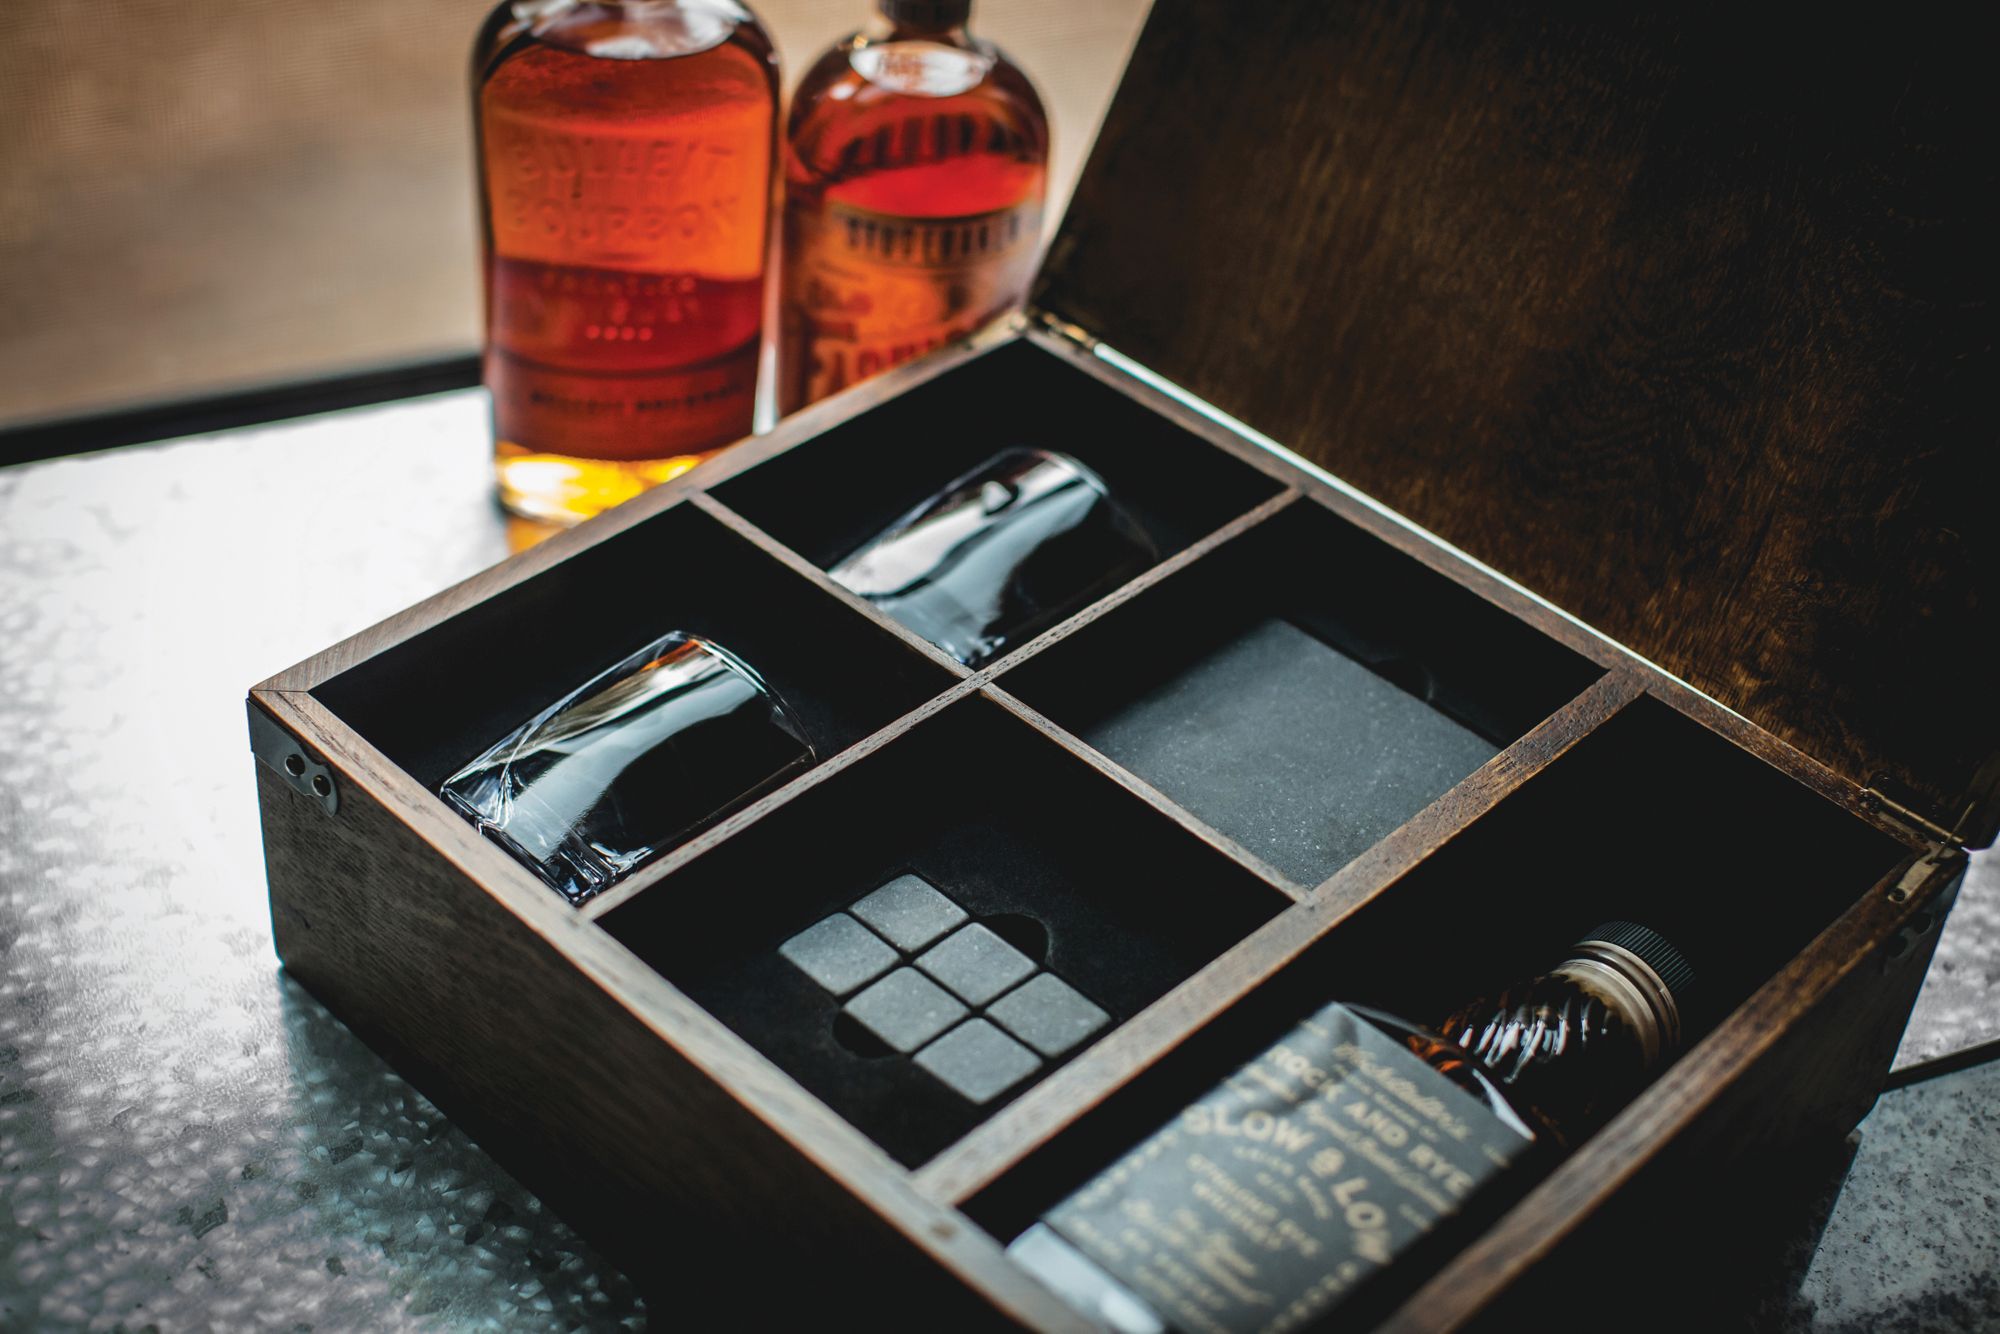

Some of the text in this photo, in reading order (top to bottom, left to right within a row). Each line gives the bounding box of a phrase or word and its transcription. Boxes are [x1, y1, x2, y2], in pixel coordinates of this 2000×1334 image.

[1182, 1104, 1315, 1155] SLOW
[1264, 1044, 1349, 1103] ROCK
[1338, 1096, 1415, 1150] AND
[1403, 1142, 1479, 1197] RYE
